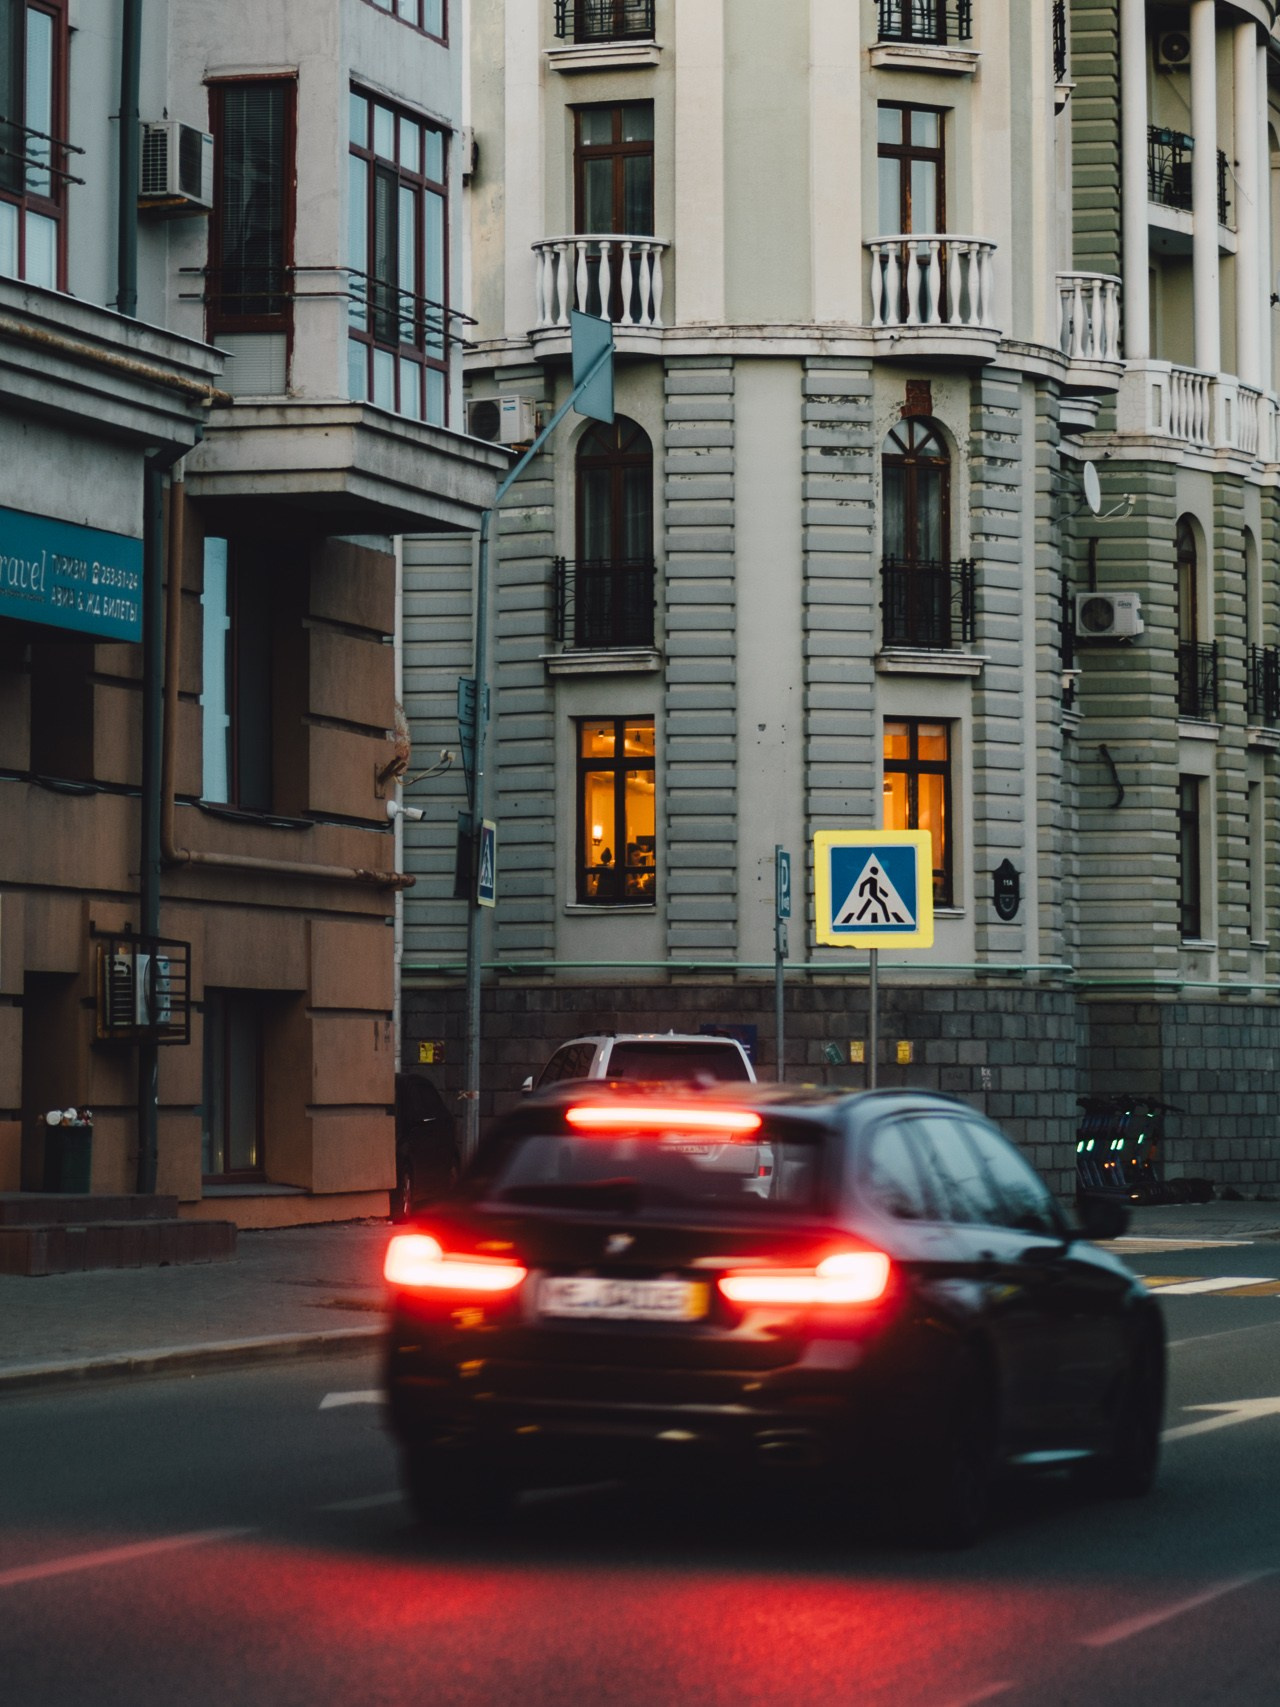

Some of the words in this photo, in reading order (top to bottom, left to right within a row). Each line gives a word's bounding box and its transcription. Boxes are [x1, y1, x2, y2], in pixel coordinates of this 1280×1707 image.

[0, 550, 46, 592] ravel
[51, 554, 87, 581] ТУРИЗМ
[51, 586, 75, 609] АВИА
[86, 592, 100, 616] ЖД
[103, 596, 138, 622] БИЛЕТЫ
